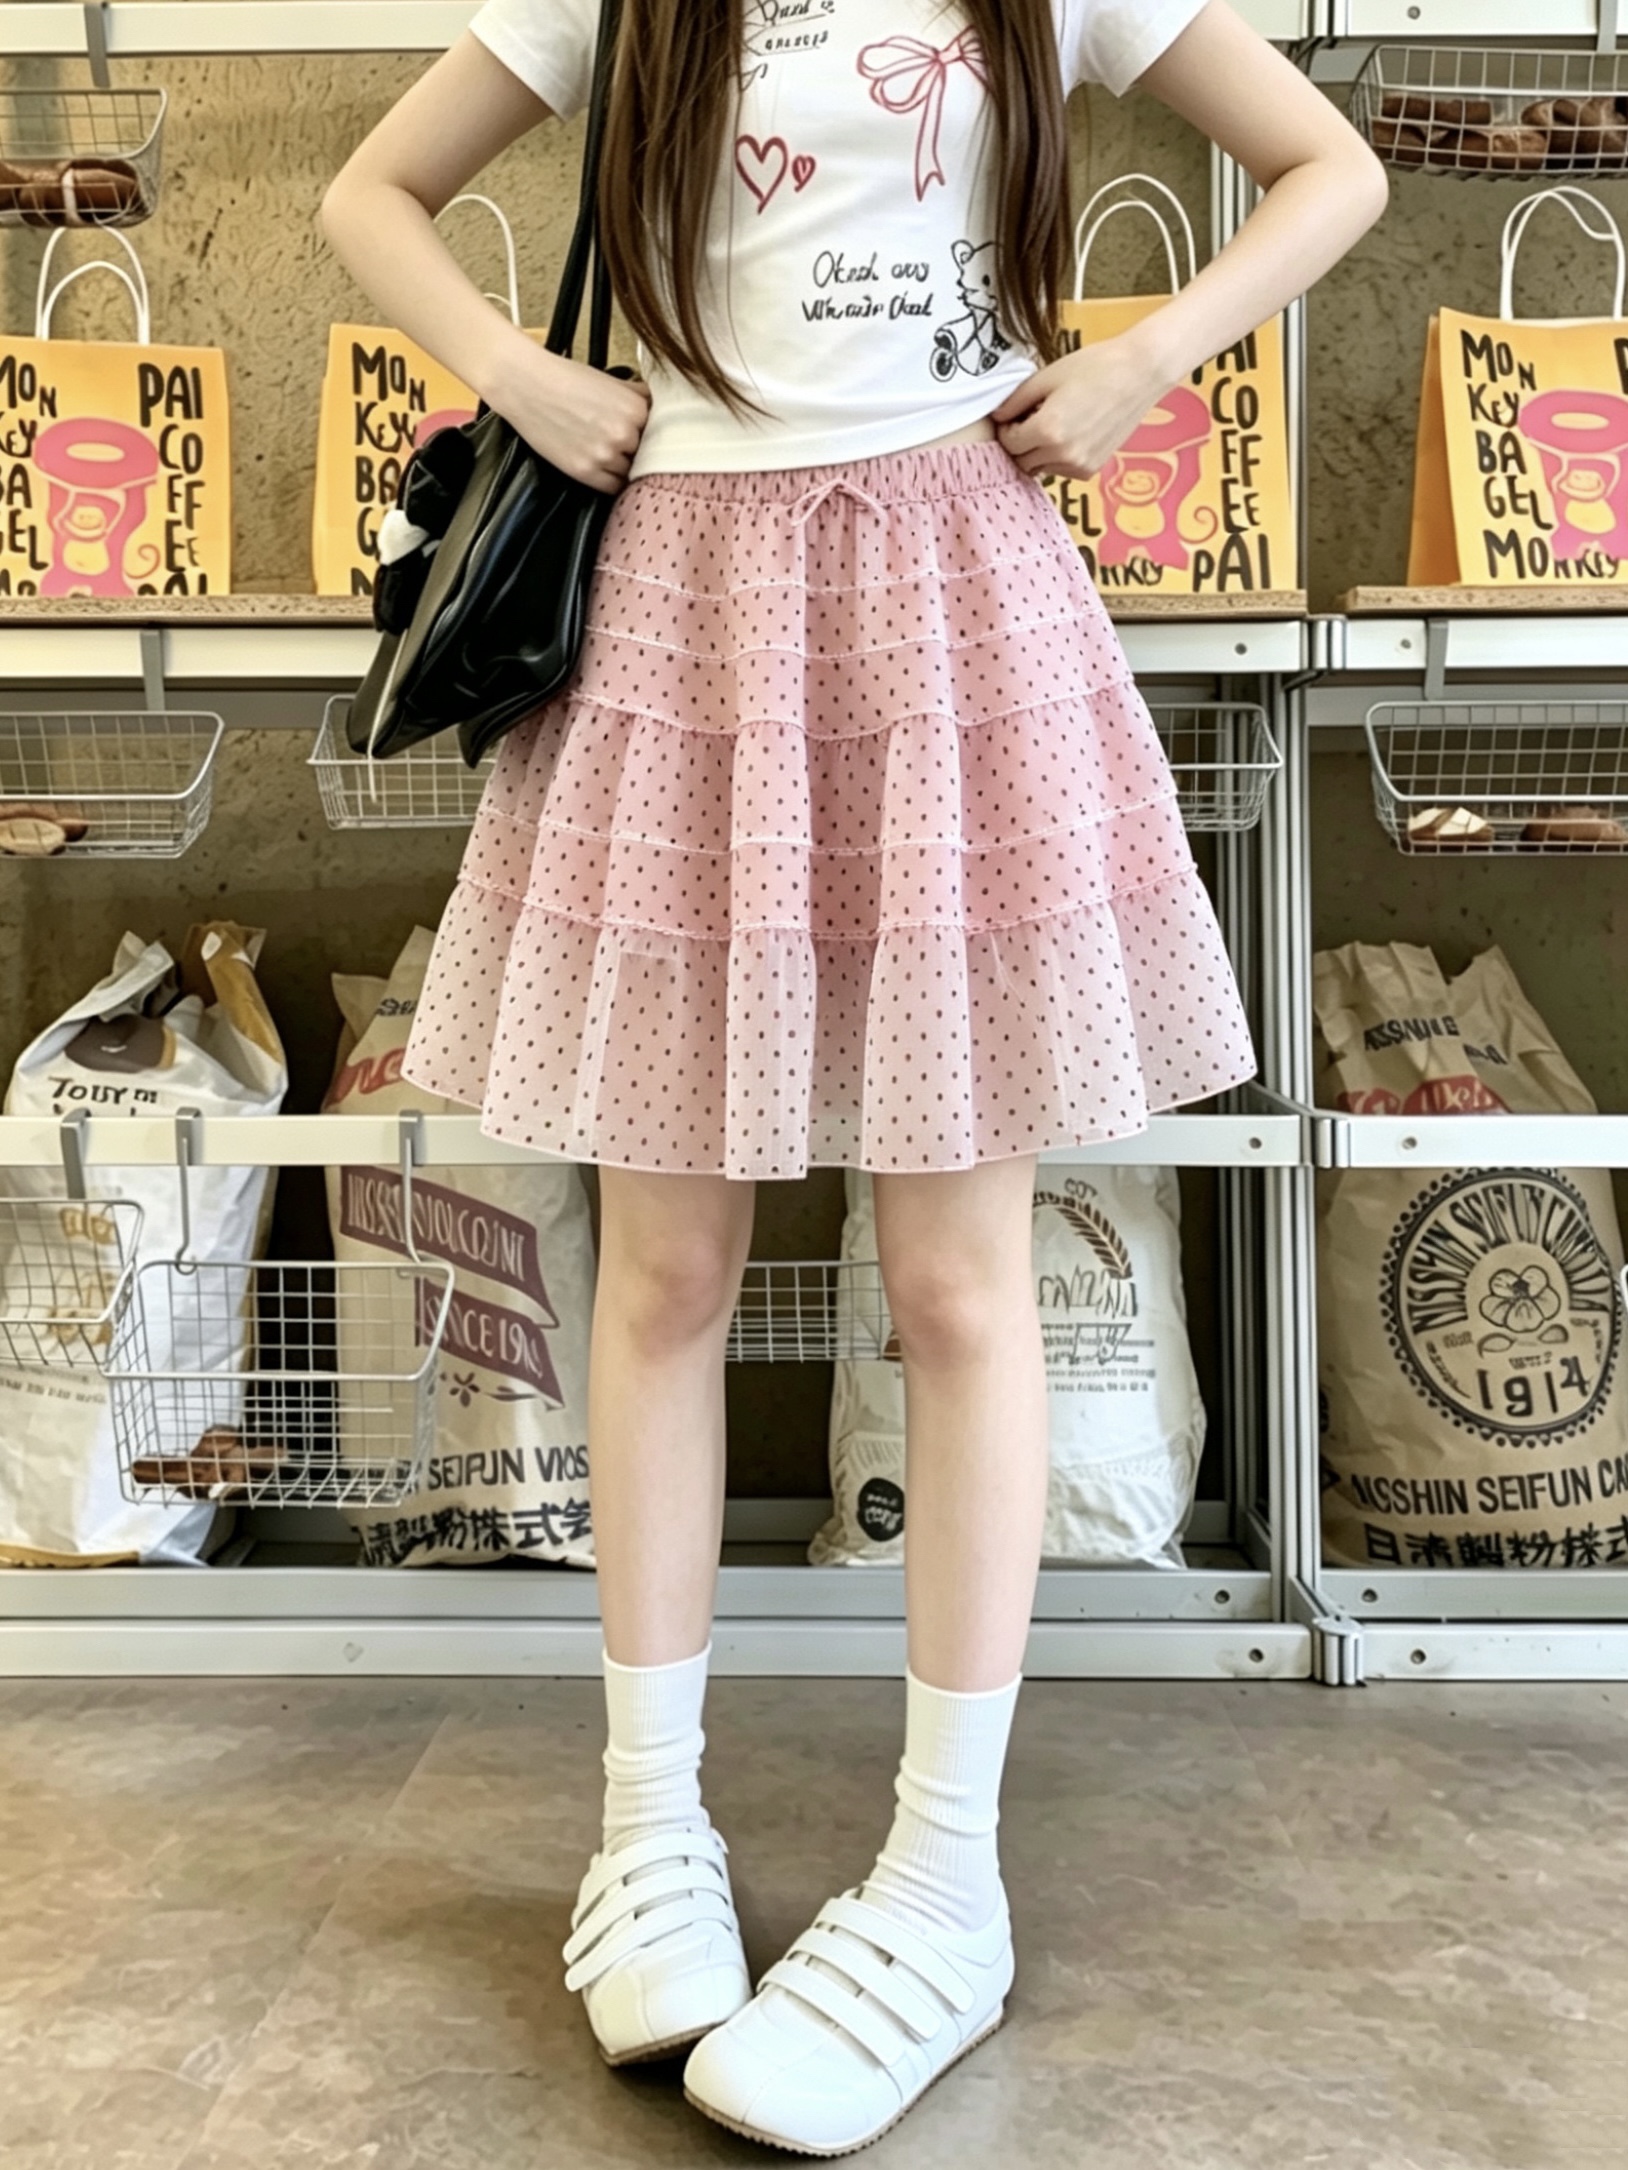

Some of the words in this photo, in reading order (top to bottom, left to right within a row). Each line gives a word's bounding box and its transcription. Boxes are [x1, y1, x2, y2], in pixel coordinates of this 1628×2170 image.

[351, 341, 426, 413] MON
[1460, 329, 1537, 391] MON
[138, 362, 204, 428] PAI
[1193, 534, 1272, 593] PAI
